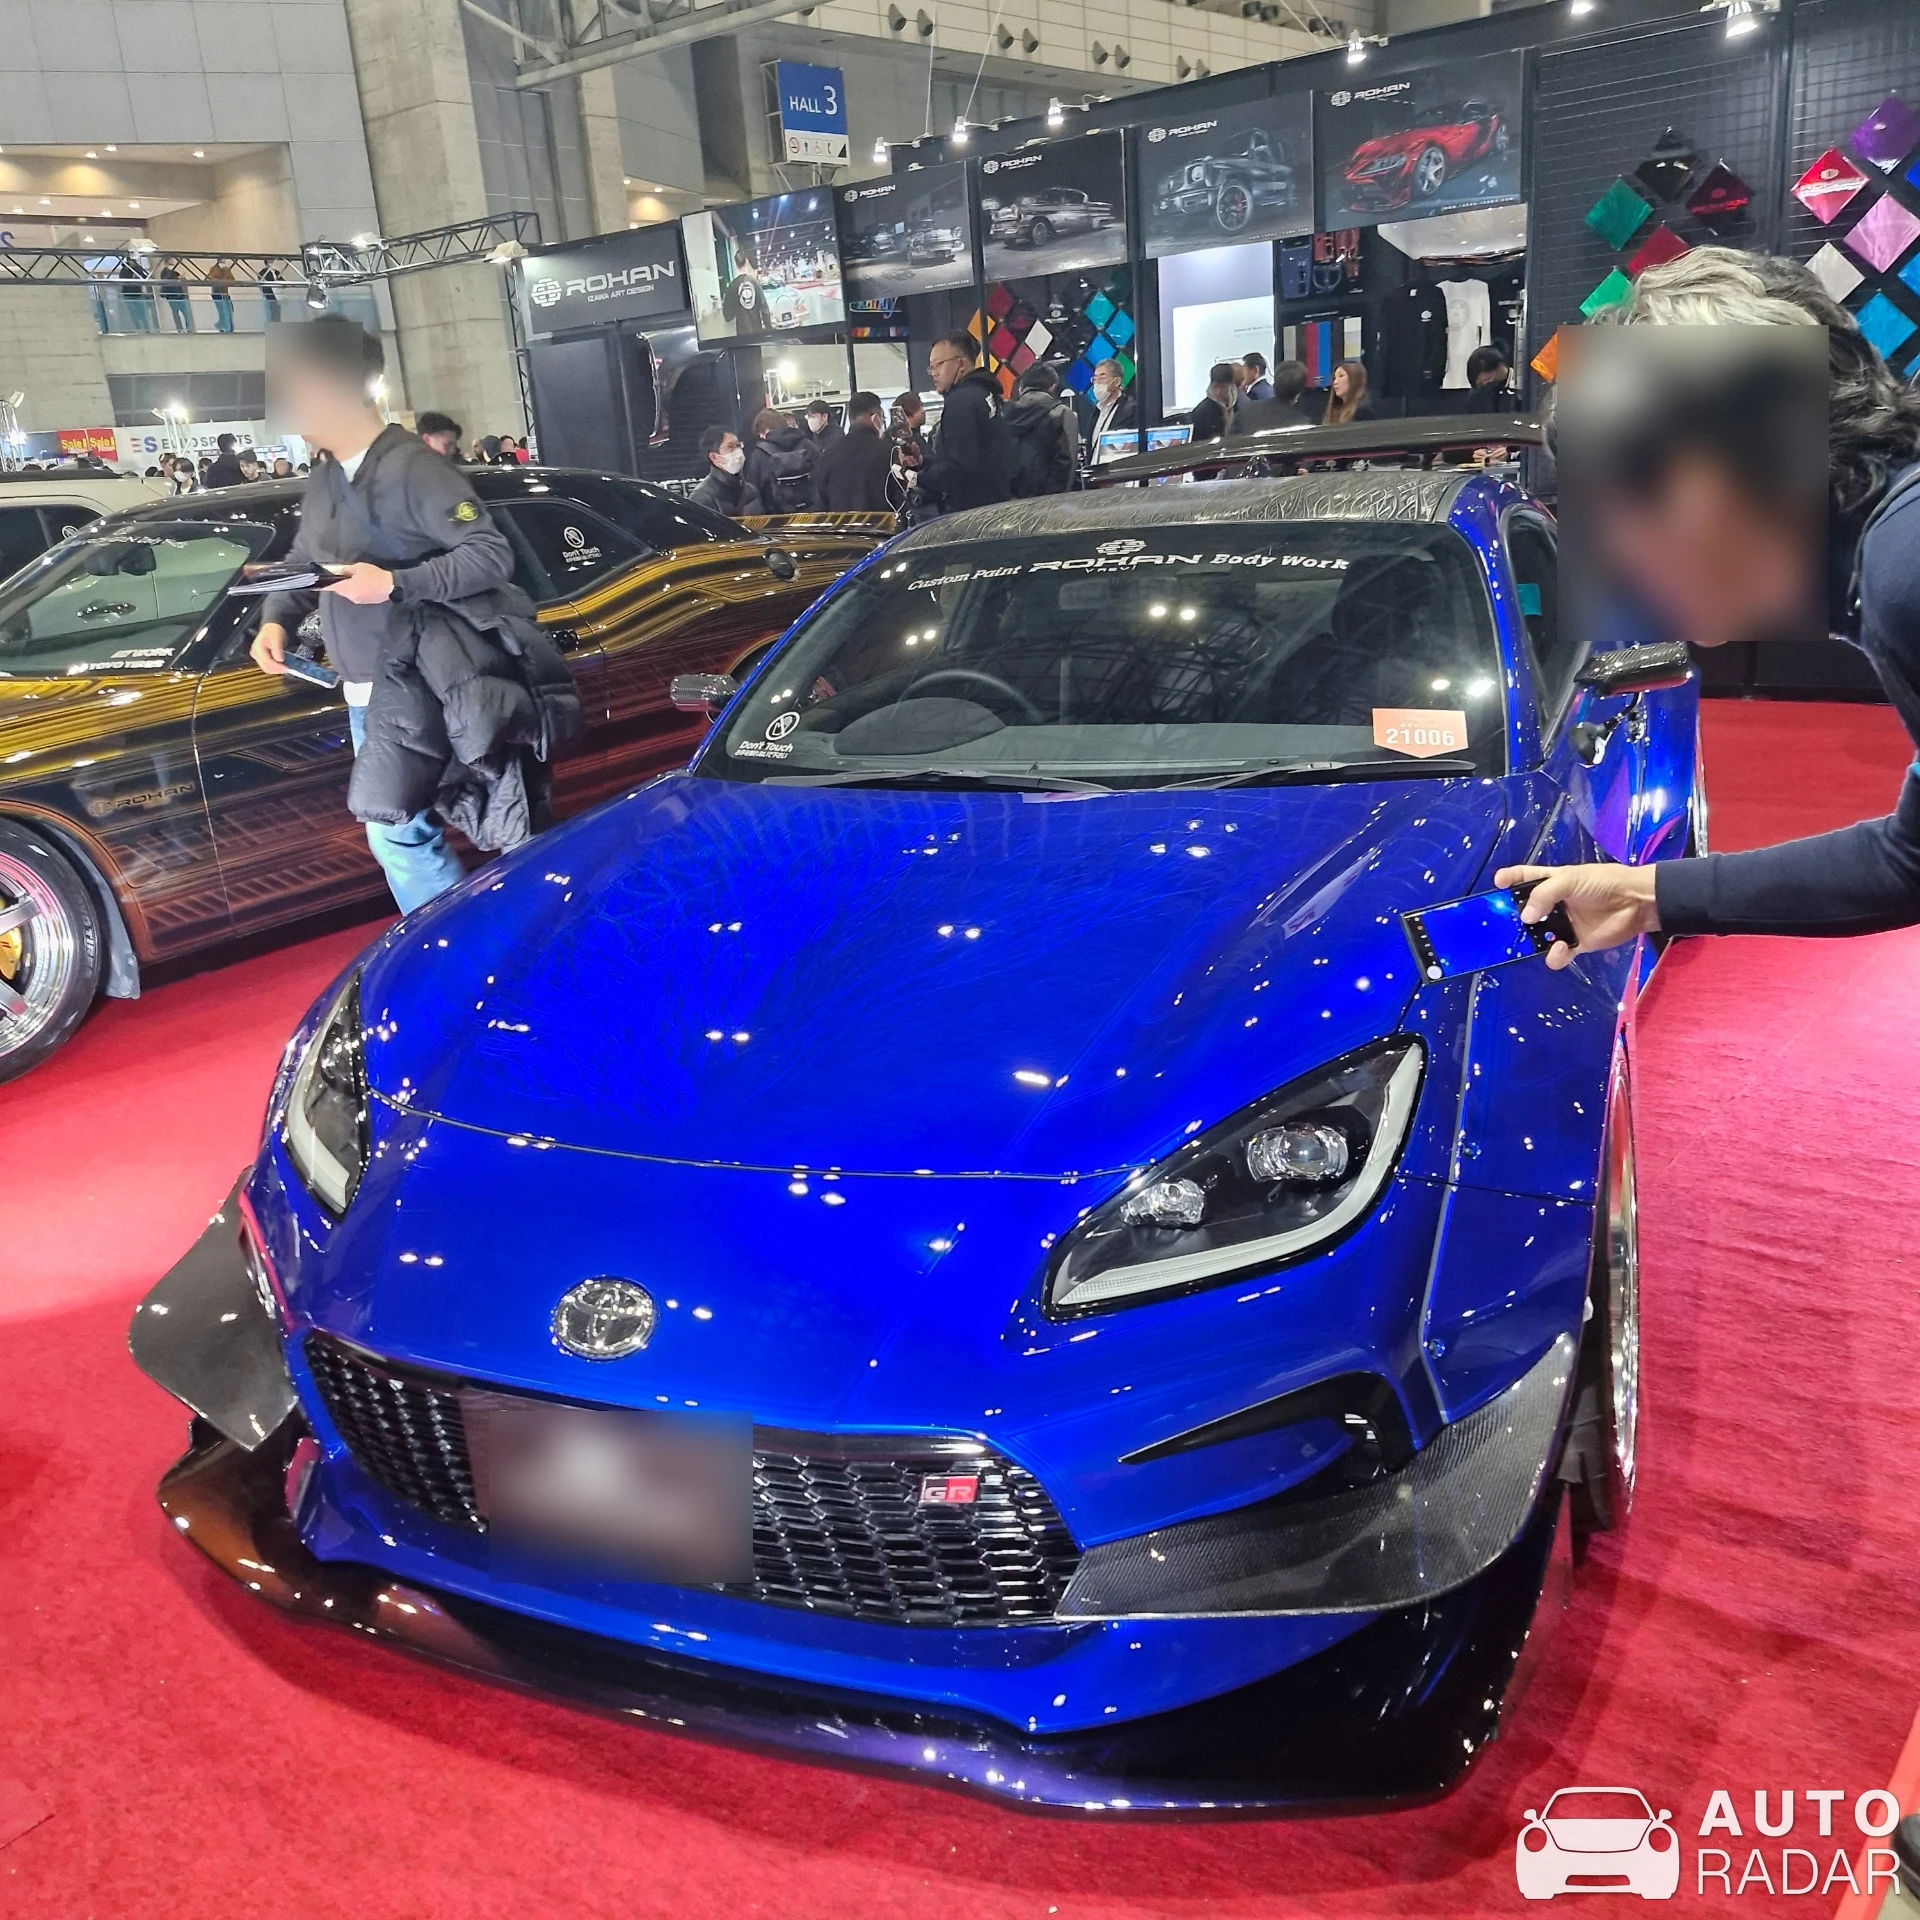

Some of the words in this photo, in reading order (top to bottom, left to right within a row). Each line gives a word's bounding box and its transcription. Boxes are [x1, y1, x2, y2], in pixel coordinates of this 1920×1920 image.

[1353, 81, 1411, 100] ROHAN
[789, 95, 822, 113] HALL
[823, 85, 838, 115] 3
[1168, 120, 1218, 136] ROHAN
[1000, 154, 1043, 168] ROHAN
[859, 184, 896, 198] ROHAN
[565, 260, 675, 297] ROHAN
[587, 294, 610, 302] IZAWA
[610, 289, 626, 299] ART
[626, 284, 655, 295] DESIGN
[562, 549, 581, 558] Don't
[579, 546, 601, 555] Touch
[907, 573, 970, 591] Custom
[970, 565, 1022, 580] Paint
[1028, 554, 1203, 573] ROHAN
[1210, 553, 1277, 568] Body
[1280, 555, 1350, 570] Work
[1385, 727, 1455, 747] 21006
[739, 740, 766, 750] Don't
[764, 742, 794, 753] Touch
[116, 783, 194, 808] ROHAN
[924, 1486, 972, 1501] GR
